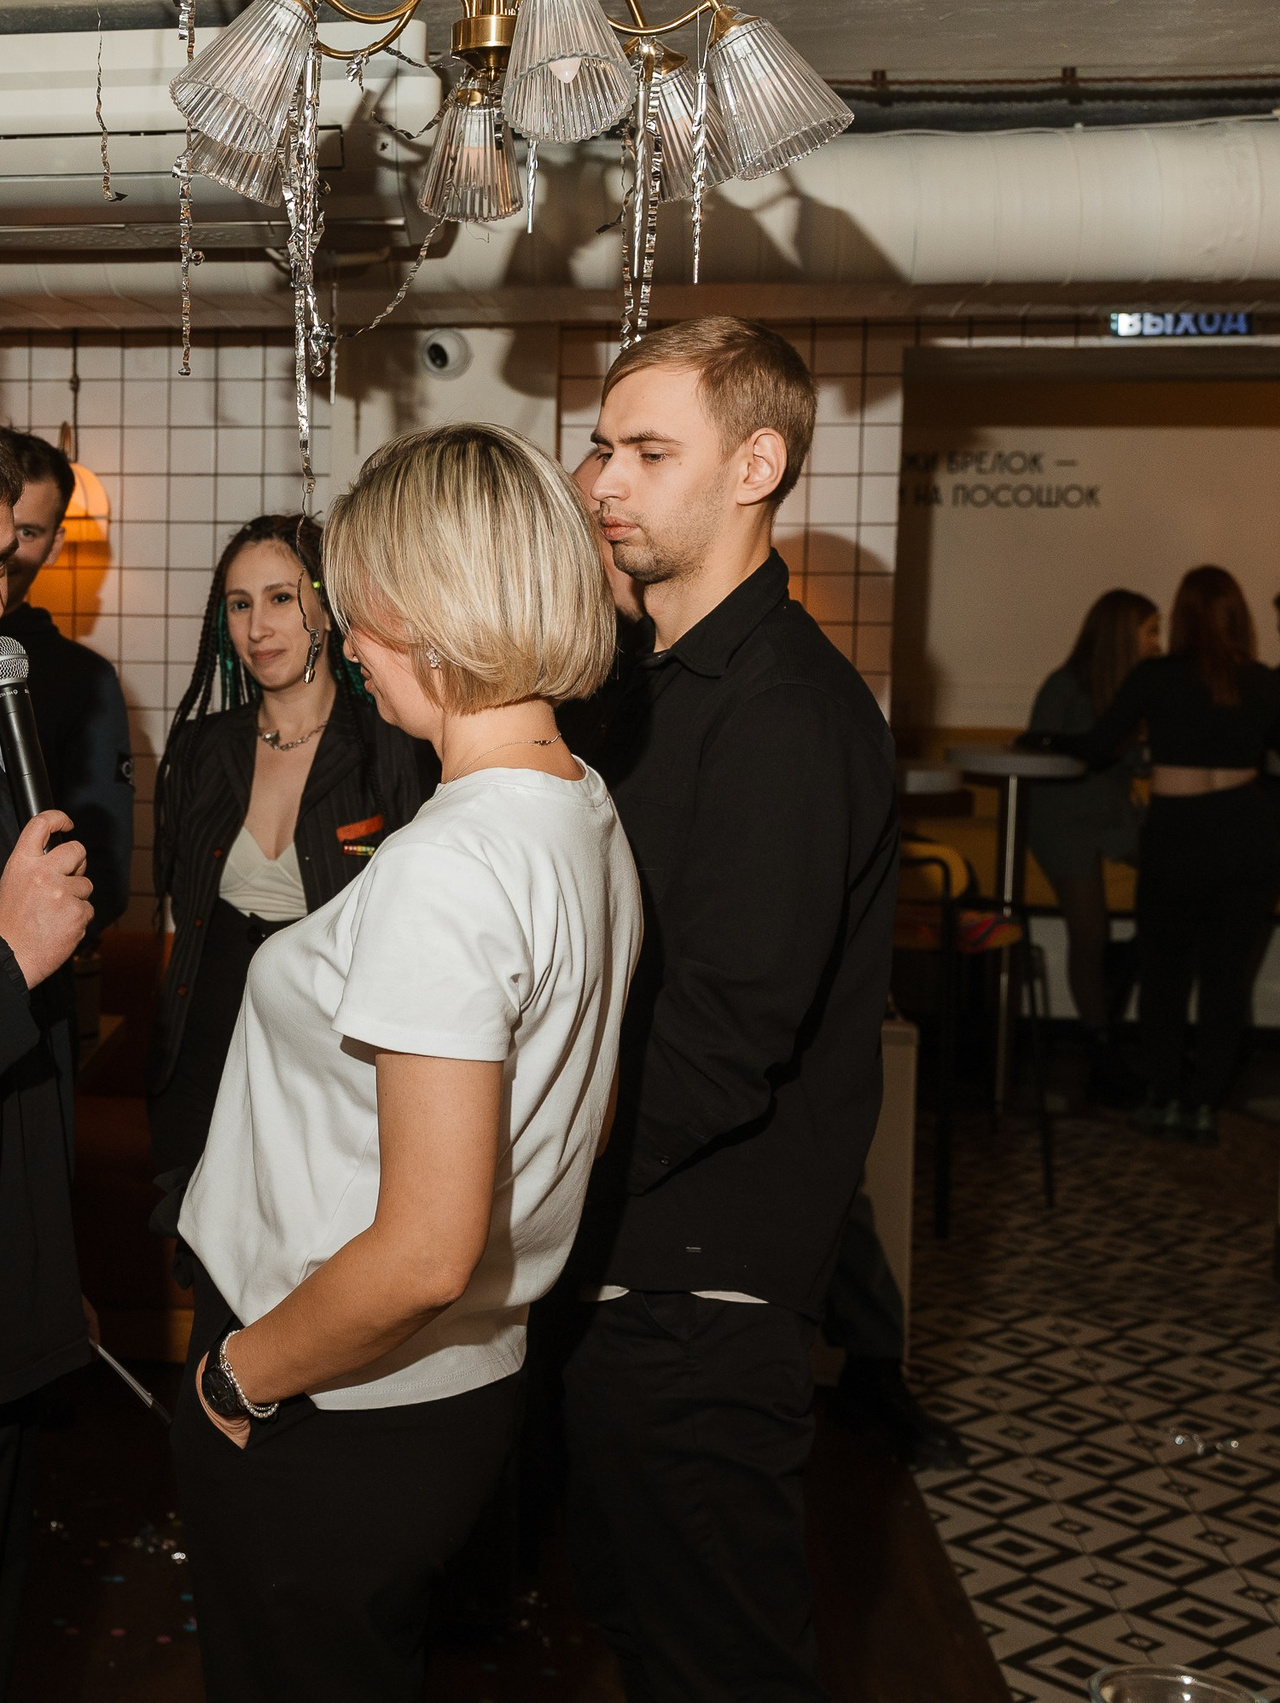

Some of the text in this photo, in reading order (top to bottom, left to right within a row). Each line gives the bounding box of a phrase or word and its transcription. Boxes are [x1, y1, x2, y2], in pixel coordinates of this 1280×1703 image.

[1117, 313, 1248, 336] ВЫХОД
[946, 451, 1045, 475] БРЕЛОК
[952, 483, 1101, 508] ПОСОШОК
